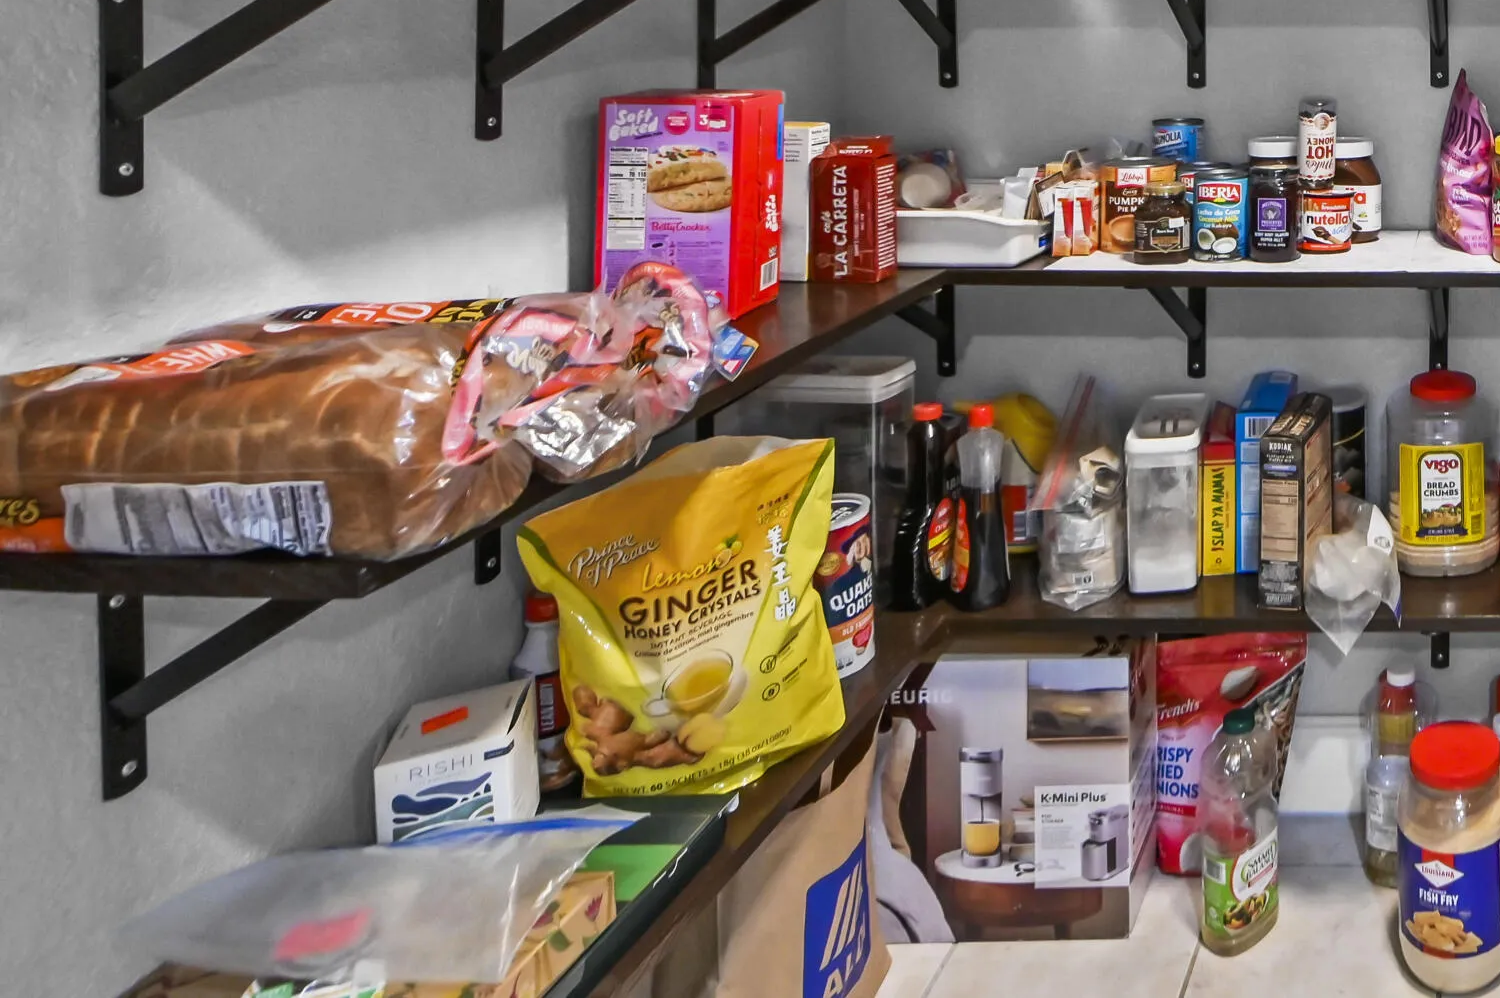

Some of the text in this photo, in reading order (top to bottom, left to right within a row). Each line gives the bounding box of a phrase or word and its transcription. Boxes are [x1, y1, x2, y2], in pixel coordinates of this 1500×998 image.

[616, 108, 653, 126] Soft
[699, 114, 709, 126] 3
[608, 116, 659, 142] Baked
[1306, 137, 1335, 145] HONEY
[1306, 145, 1334, 159] HOT
[1121, 172, 1144, 183] Libby's
[1198, 186, 1239, 200] IBERIA
[1109, 197, 1145, 205] PUMPK
[651, 221, 712, 232] Betty Crocker
[832, 165, 849, 279] LA CARRETA
[1306, 214, 1348, 225] nutella
[1269, 442, 1293, 452] KODIAK
[1424, 459, 1459, 474] vigo
[1424, 489, 1459, 497] CRUMBS
[1211, 473, 1225, 548] SLAP YA MAMA
[618, 559, 761, 626] GINGER
[624, 585, 761, 639] HONEY CRYSTALS
[890, 689, 952, 704] EURIG
[649, 782, 664, 793] 60
[1156, 782, 1199, 798] NIONS
[1081, 792, 1107, 803] Plus
[1421, 865, 1455, 879] LOUISIANA
[1419, 888, 1459, 907] FISH FRY
